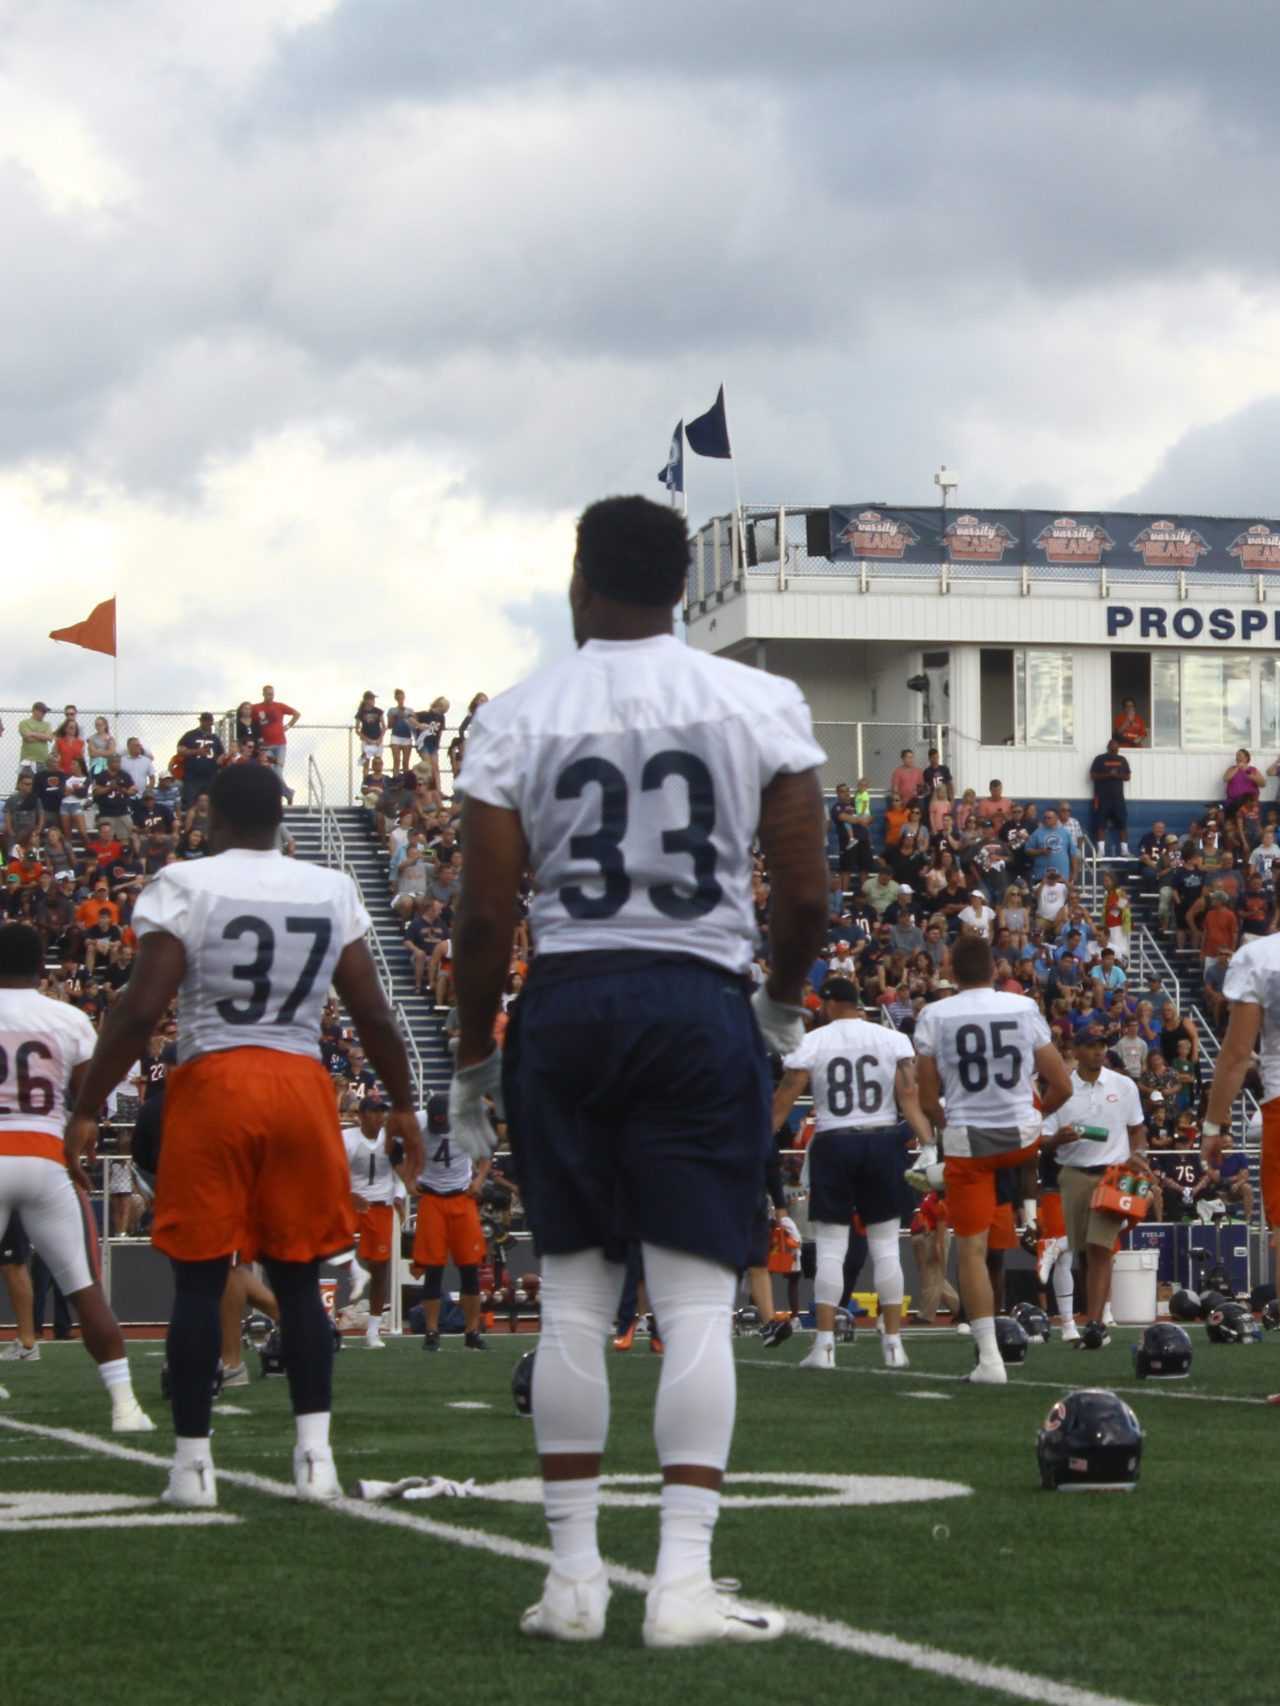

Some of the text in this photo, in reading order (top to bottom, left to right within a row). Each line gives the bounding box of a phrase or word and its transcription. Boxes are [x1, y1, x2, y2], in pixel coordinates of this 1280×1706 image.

[555, 750, 723, 921] 33
[216, 914, 333, 1025] 37
[0, 1040, 56, 1117] 6
[826, 1054, 884, 1117] 86
[955, 1021, 1023, 1092] 85
[368, 1153, 376, 1186] 1
[432, 1138, 451, 1170] 4
[1176, 1166, 1194, 1183] 76
[1119, 1195, 1132, 1211] G
